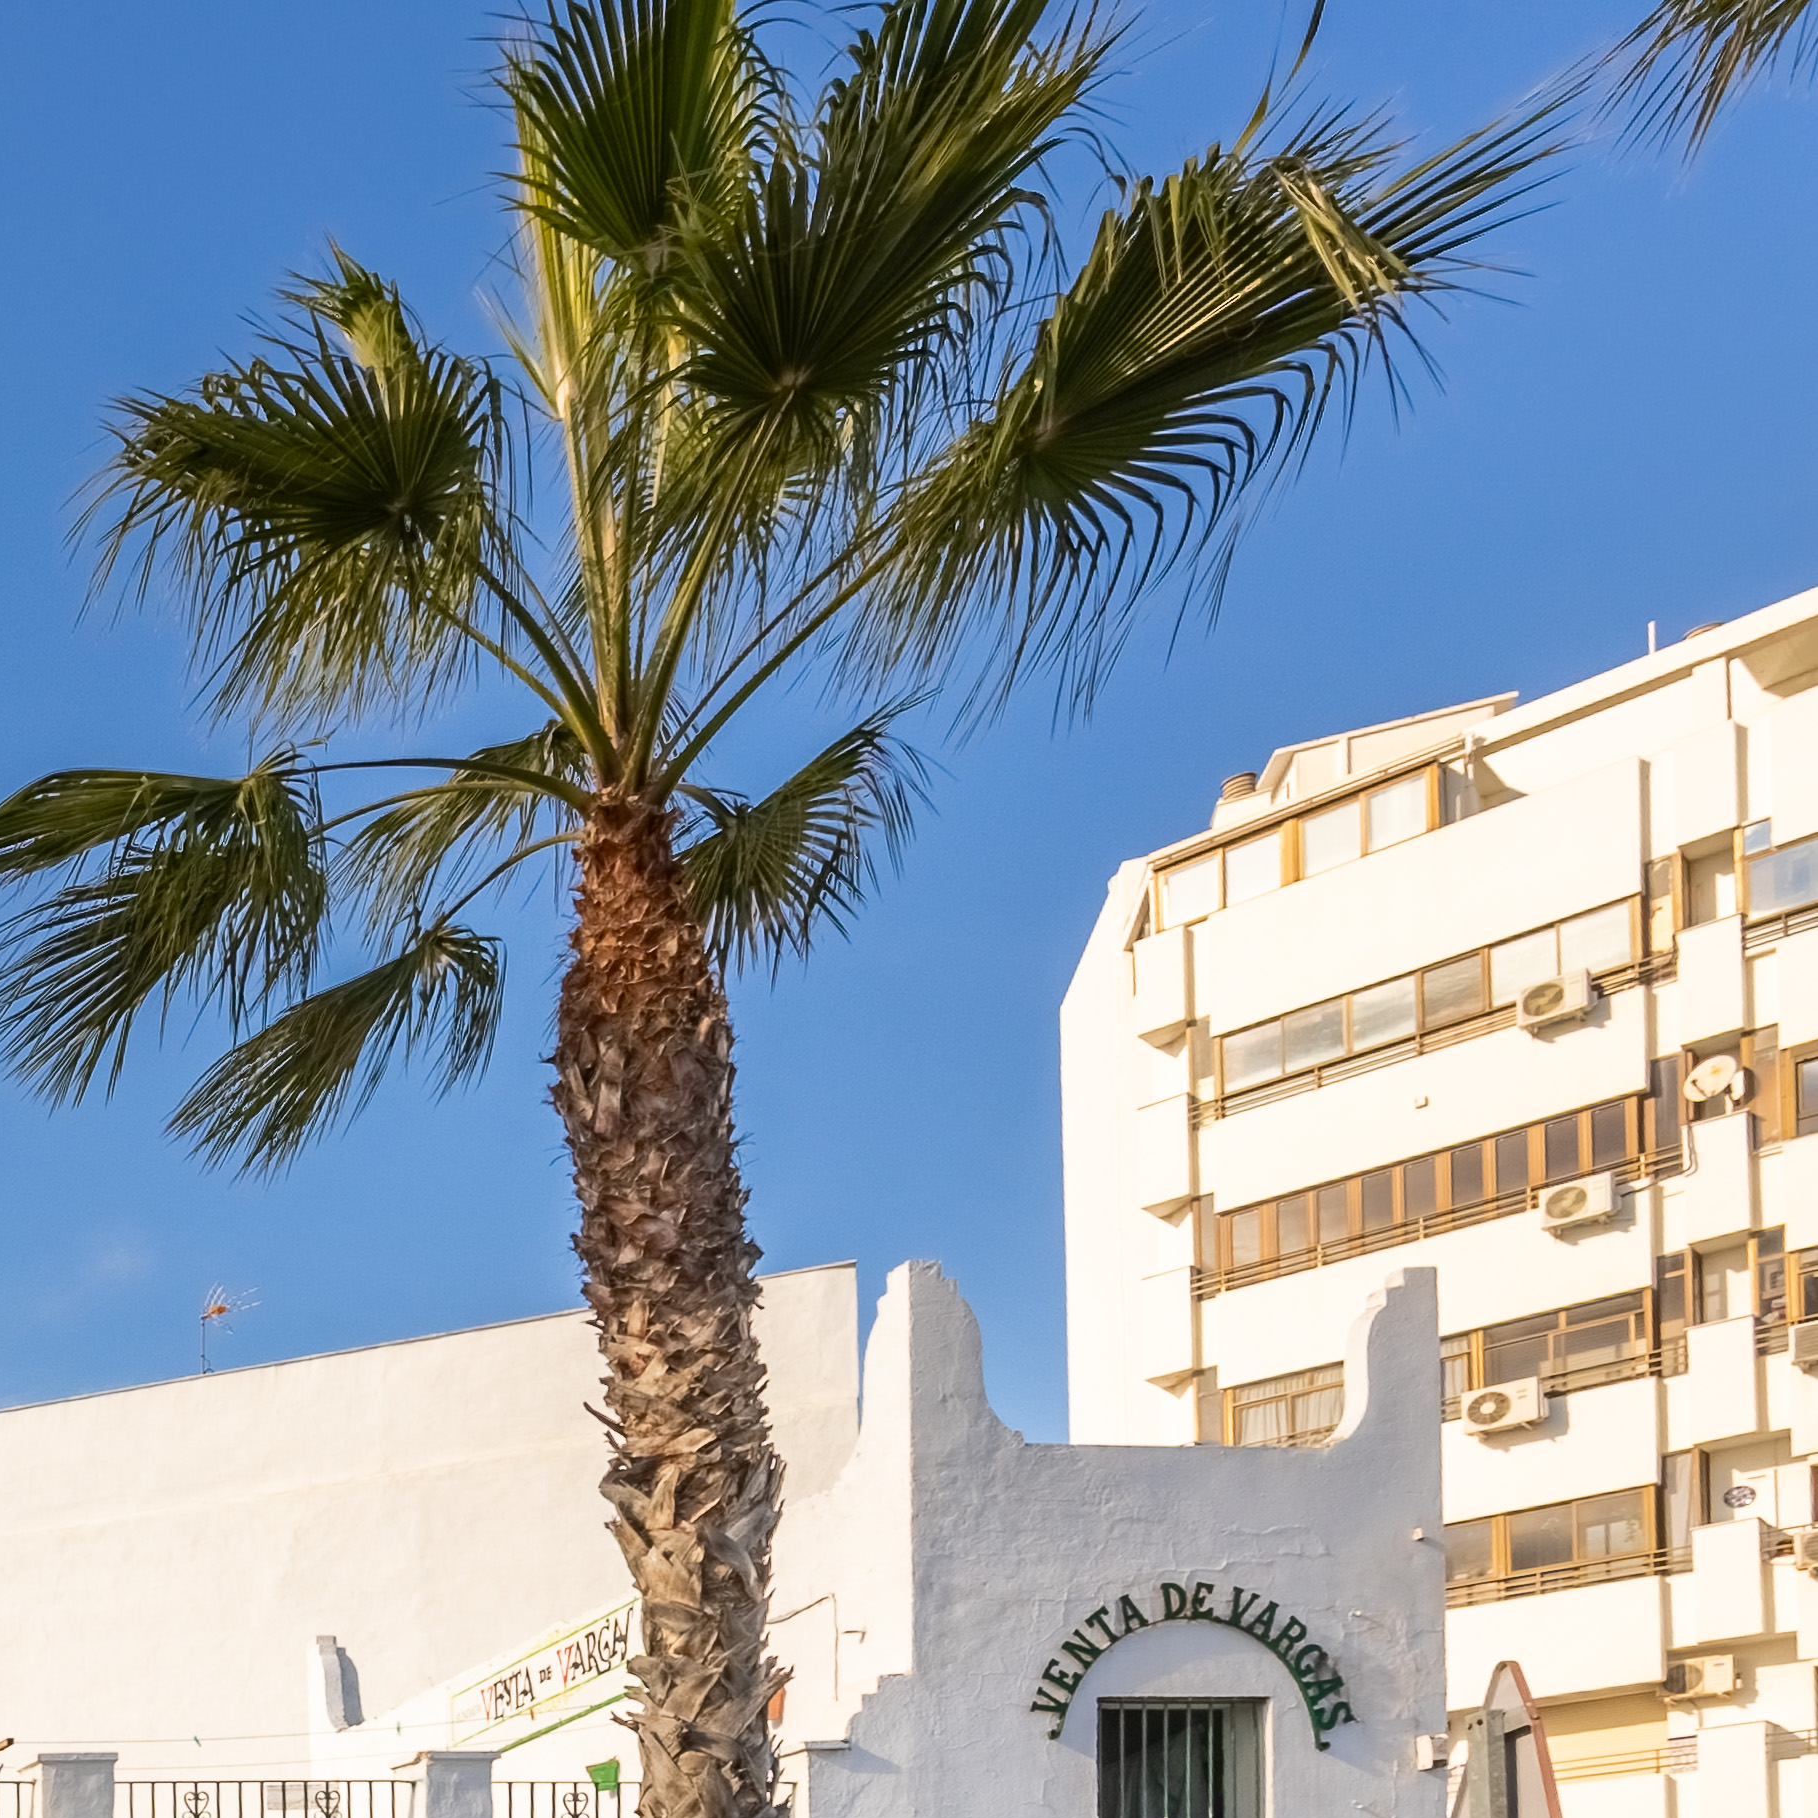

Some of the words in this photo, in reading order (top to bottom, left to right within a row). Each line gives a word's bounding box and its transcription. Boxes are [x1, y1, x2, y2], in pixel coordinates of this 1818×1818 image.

[539, 1665, 552, 1684] DE
[1030, 1594, 1149, 1720] VENTA
[1160, 1581, 1215, 1620] DE
[1228, 1586, 1357, 1732] VARGAS
